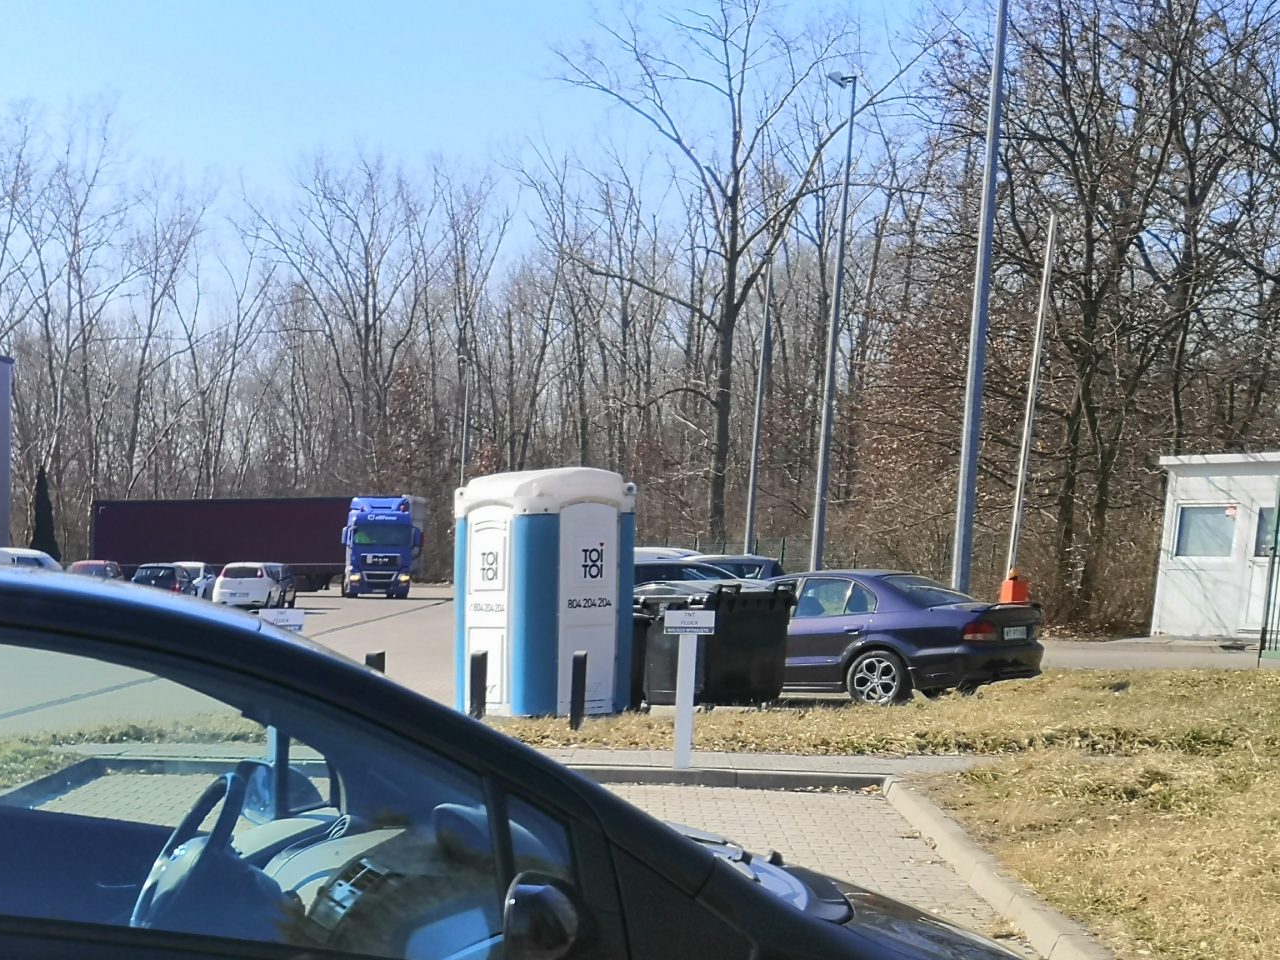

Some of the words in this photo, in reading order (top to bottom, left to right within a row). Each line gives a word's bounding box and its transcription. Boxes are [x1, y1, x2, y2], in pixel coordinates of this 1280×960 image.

[480, 551, 499, 567] TOI
[480, 567, 499, 581] TOI
[581, 563, 604, 579] TOI
[567, 599, 582, 609] 804
[582, 598, 597, 608] 204
[597, 597, 612, 607] 204
